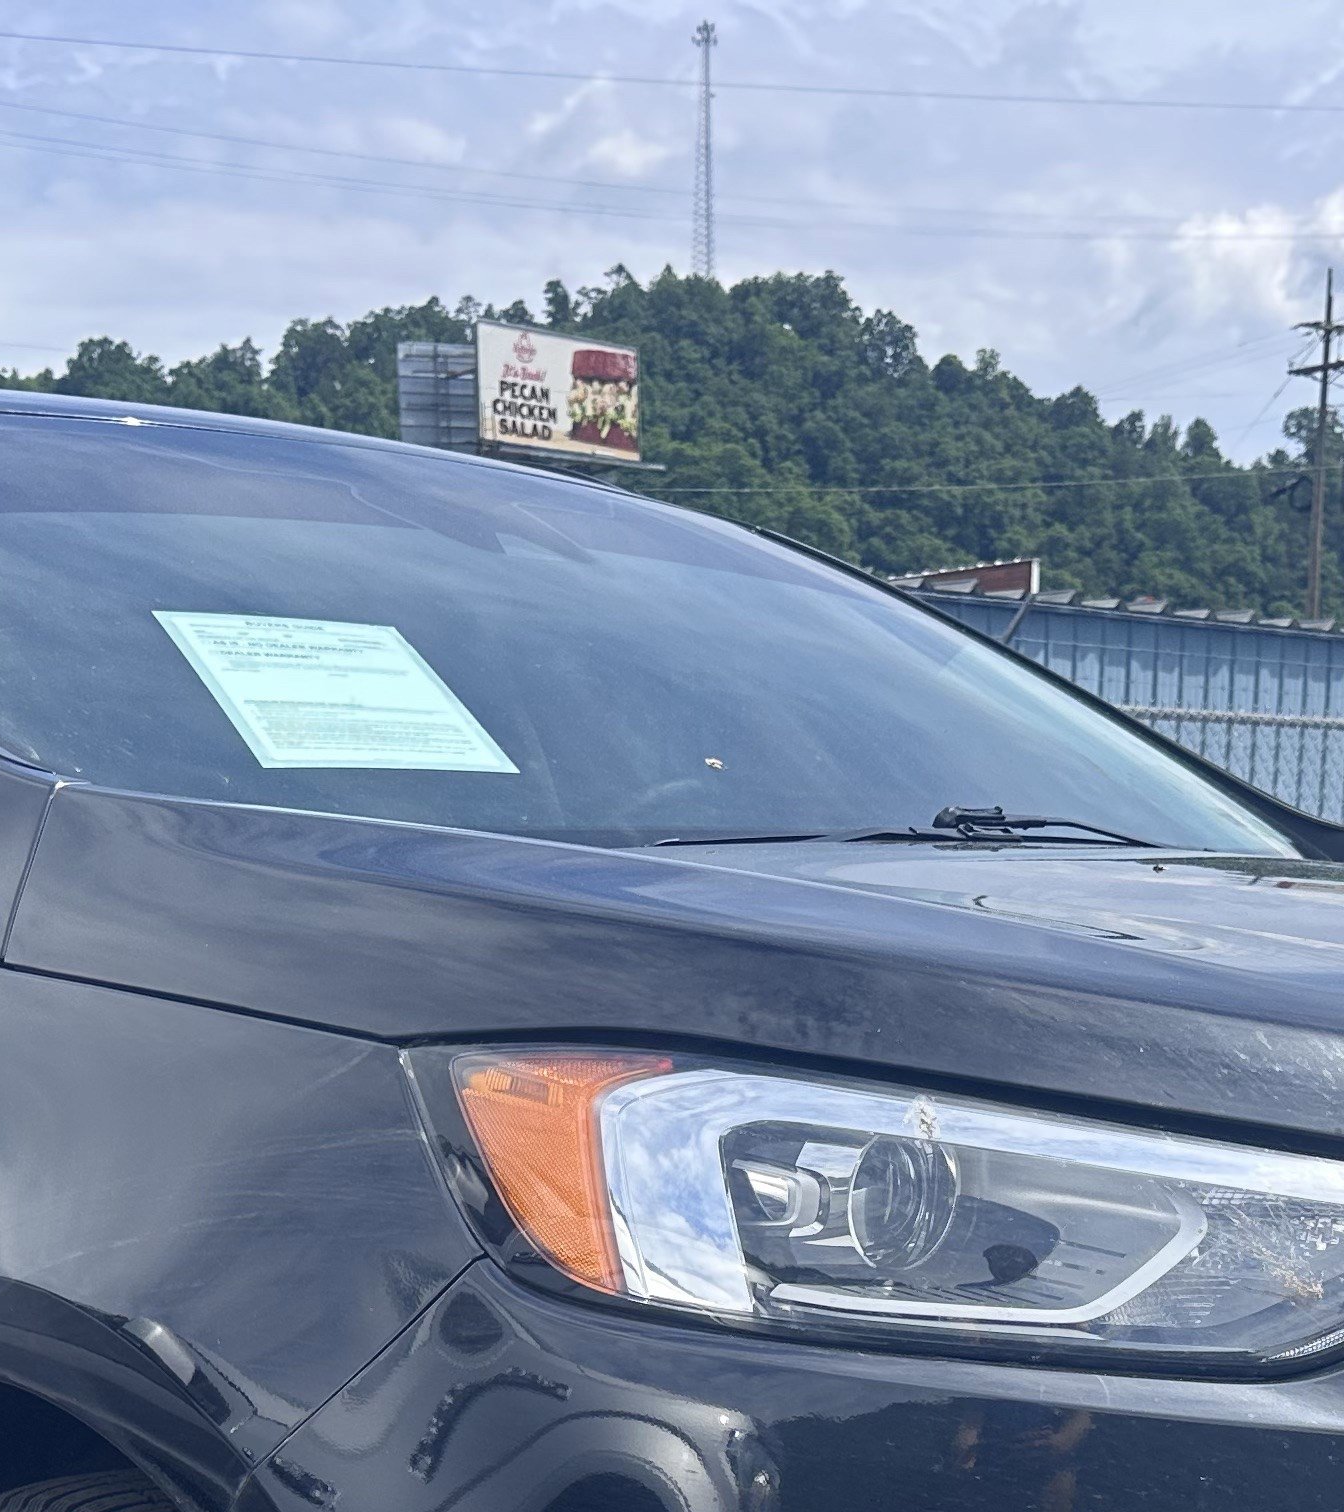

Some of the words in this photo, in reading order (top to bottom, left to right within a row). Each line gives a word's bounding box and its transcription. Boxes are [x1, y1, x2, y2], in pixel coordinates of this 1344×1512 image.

[499, 379, 550, 402] PECAN
[493, 398, 557, 424] CHICKEN
[499, 417, 552, 441] SALAD
